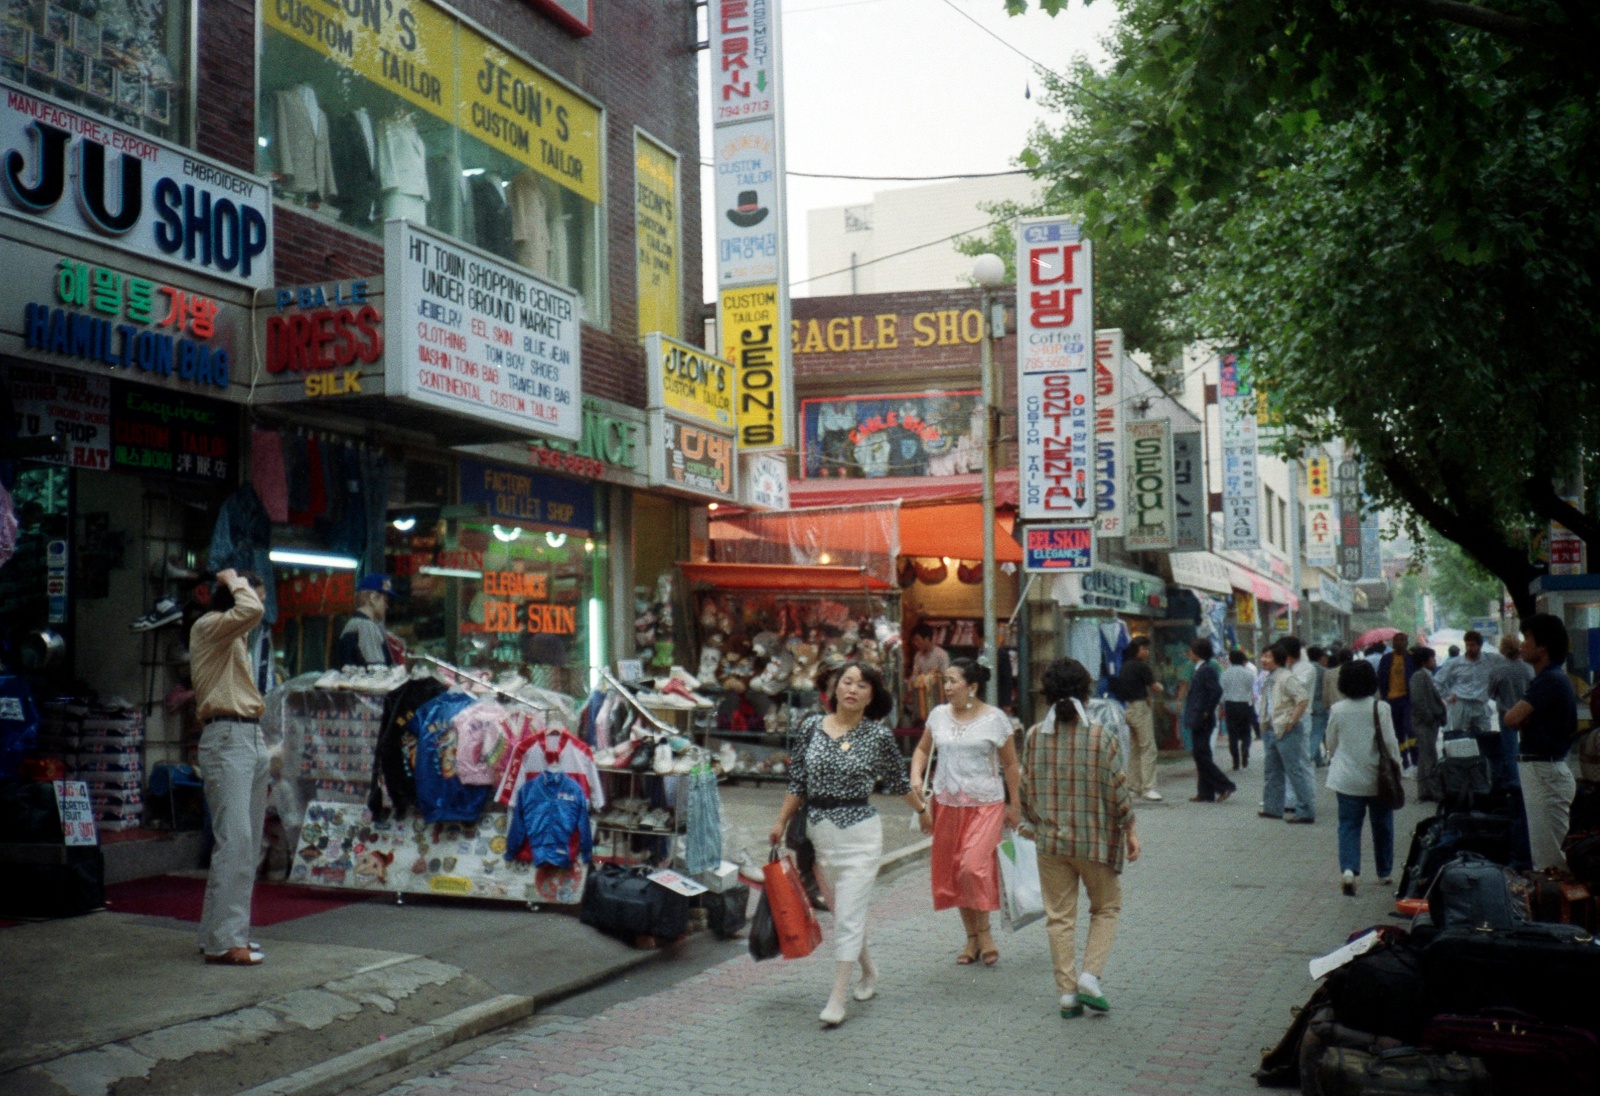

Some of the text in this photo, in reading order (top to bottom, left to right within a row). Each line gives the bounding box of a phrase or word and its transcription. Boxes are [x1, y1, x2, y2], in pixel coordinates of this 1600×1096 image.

[276, 0, 443, 106] CUSTOM TAILOR
[8, 91, 101, 140] MANUFACTURE
[112, 131, 159, 163] EXPORT
[476, 59, 570, 142] JEON'S
[471, 101, 585, 184] CUSTOM TAILOR
[3, 120, 267, 279] JU SHOP
[183, 159, 254, 198] EMBROIDERY
[58, 258, 218, 338] 해밀톤 가방
[409, 236, 572, 322] HIT TOWN SHOPPING CENTER
[422, 267, 562, 340] UNDER GROUND MARKET
[723, 292, 776, 310] CUSTOM
[1030, 244, 1082, 329] 다방
[266, 306, 384, 374] DRESS
[417, 299, 570, 365] JEWELRY EEL SKIN BLUE JEAN
[733, 311, 770, 325] TAILOR
[1029, 331, 1082, 346] Coffee
[25, 302, 230, 388] HAMILTON BAG
[417, 321, 559, 383] CLOTHING TOM BOY SHOES
[663, 346, 726, 392] JEON'S
[305, 371, 363, 397] SILK
[419, 369, 558, 422] CONTINENTAL CUSTOM TAILOR
[482, 364, 499, 385] BAG
[508, 373, 552, 399] TRAVELING
[554, 386, 571, 405] BAG
[663, 375, 696, 400] CUSTOM
[703, 389, 730, 413] TAILOR
[73, 446, 109, 469] HAT
[114, 420, 229, 459] CUSTOM TAILOR
[681, 426, 732, 493] 다방
[484, 469, 532, 492] FACTORY
[1134, 438, 1164, 528] SEOUL
[496, 494, 575, 523] OUTLET SHOP
[1104, 518, 1119, 531] 2F
[484, 571, 548, 598] ELEGANCE
[484, 601, 576, 634] EEL SKIN
